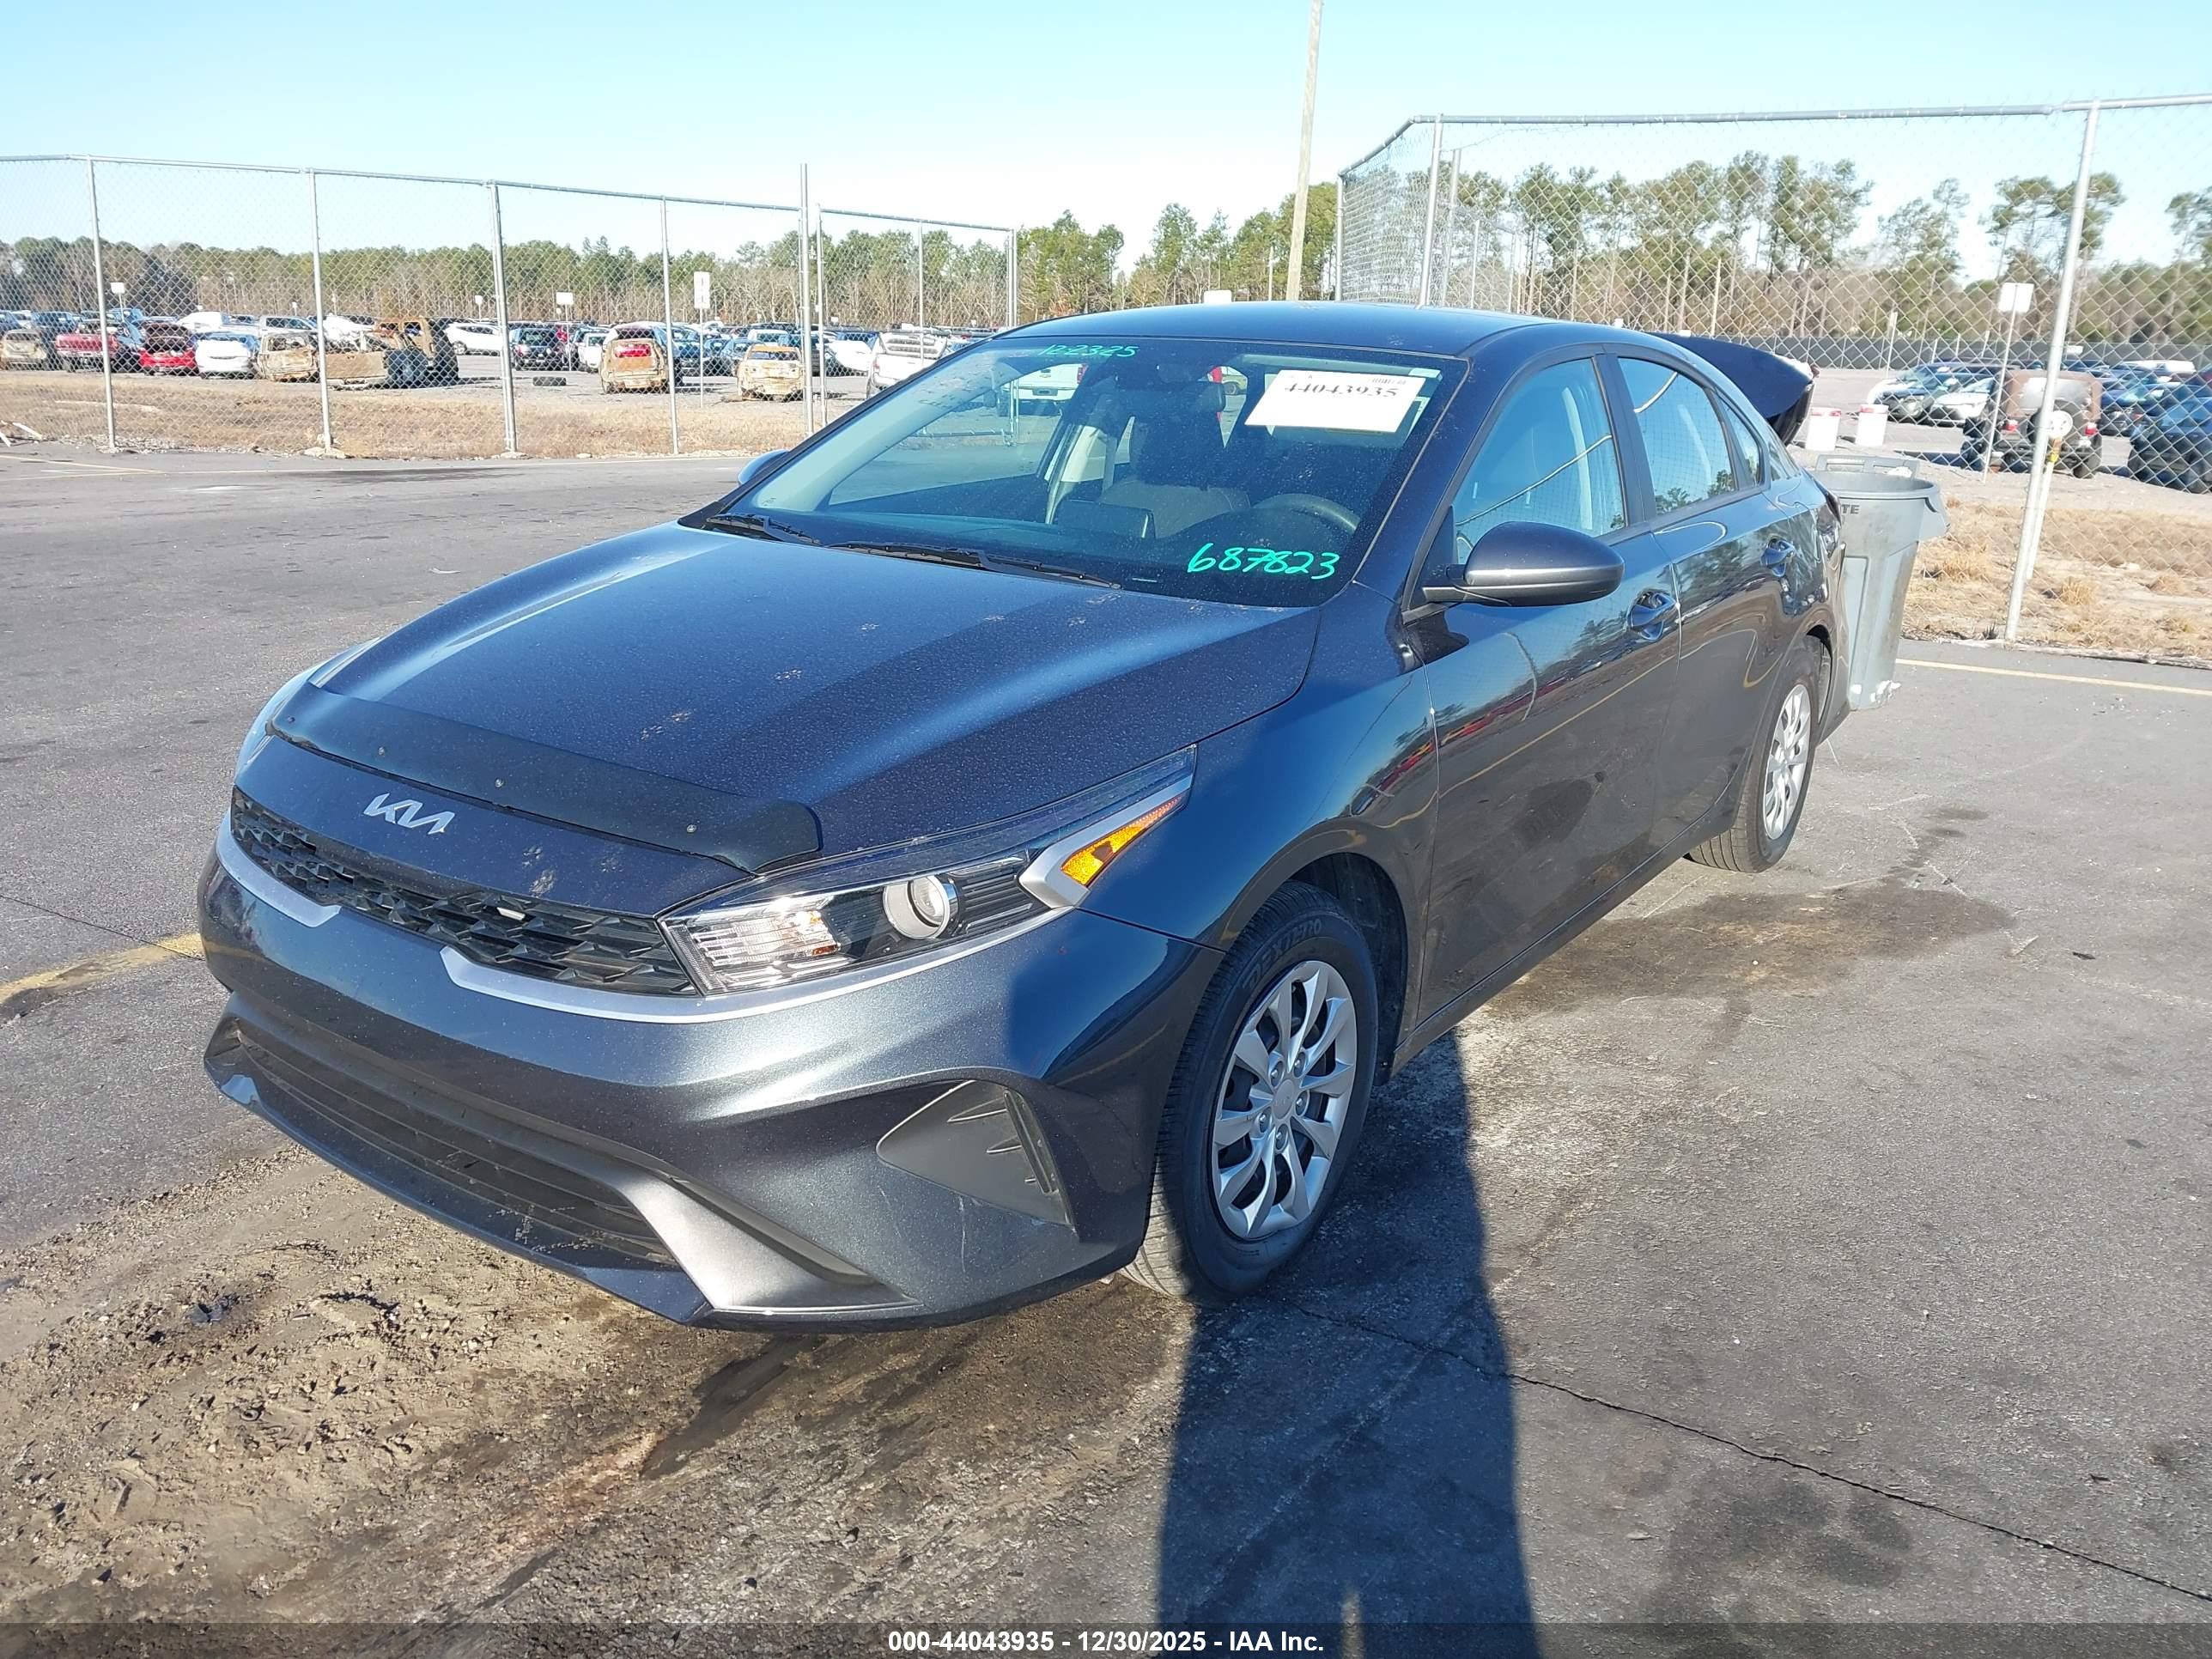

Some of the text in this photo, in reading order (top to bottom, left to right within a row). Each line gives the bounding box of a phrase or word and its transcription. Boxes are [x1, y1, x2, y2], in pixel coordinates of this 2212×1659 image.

[1285, 382, 1400, 398] 44043935
[1187, 542, 1340, 580] 687823
[363, 793, 456, 836] KIA
